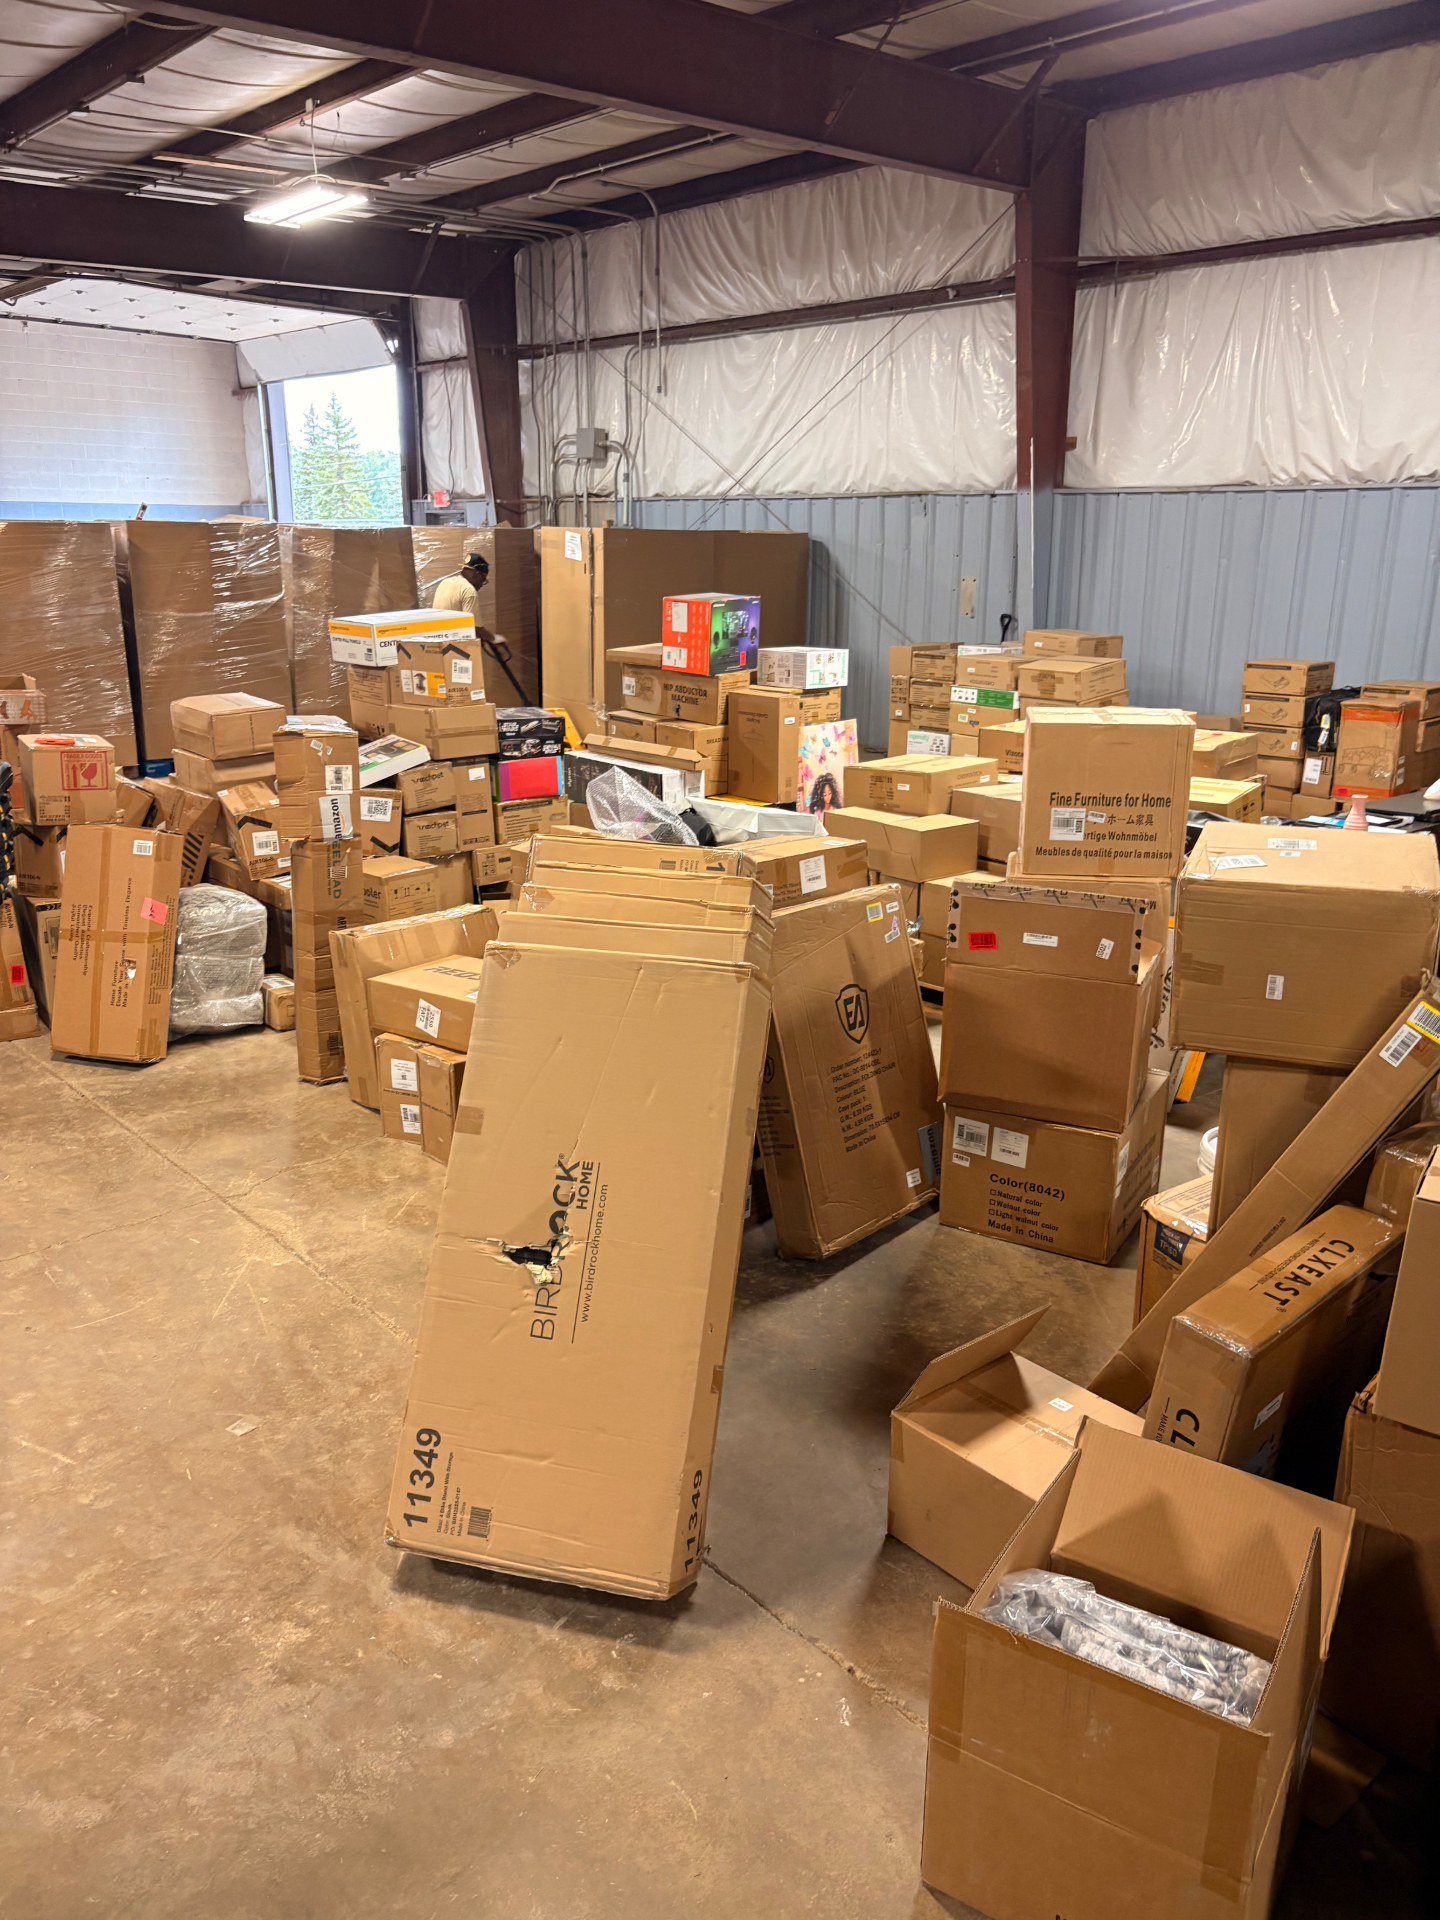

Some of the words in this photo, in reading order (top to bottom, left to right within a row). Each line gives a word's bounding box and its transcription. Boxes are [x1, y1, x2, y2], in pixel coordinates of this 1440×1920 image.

[380, 640, 396, 648] CENT
[664, 683, 674, 692] HIP
[675, 685, 708, 698] ABDUCTOR
[671, 694, 700, 706] MACHINE
[1050, 792, 1072, 806] Fine
[1074, 792, 1122, 807] Furniture
[1124, 793, 1139, 807] for
[1142, 794, 1172, 808] Home
[1083, 831, 1106, 842] ertige
[1108, 831, 1158, 842] Wohnmöbel
[1035, 846, 1070, 856] Meubles
[1072, 847, 1082, 857] de
[1083, 848, 1112, 858] qualité
[1114, 850, 1133, 860] pour
[1134, 849, 1142, 858] la
[830, 1062, 844, 1074] Order
[862, 1068, 882, 1082] FOLDING
[882, 1062, 896, 1074] CHAIR
[853, 1085, 866, 1096] BLUE
[576, 1160, 594, 1210] HOME
[990, 1174, 1065, 1202] Color(8042)
[996, 1200, 1020, 1212] Walnut
[1023, 1206, 1040, 1216] color
[997, 1190, 1022, 1202] Natural
[1025, 1197, 1042, 1208] color
[996, 1210, 1012, 1220] Light
[1016, 1214, 1038, 1226] walnut
[1041, 1221, 1060, 1232] color
[988, 1219, 1012, 1232] Made
[1016, 1226, 1024, 1236] in
[1028, 1230, 1054, 1242] China
[582, 1184, 608, 1322] www.birdrockhome.com
[1263, 1239, 1354, 1306] CLXEAST
[403, 1428, 442, 1528] 11349
[684, 1470, 702, 1573] 11349
